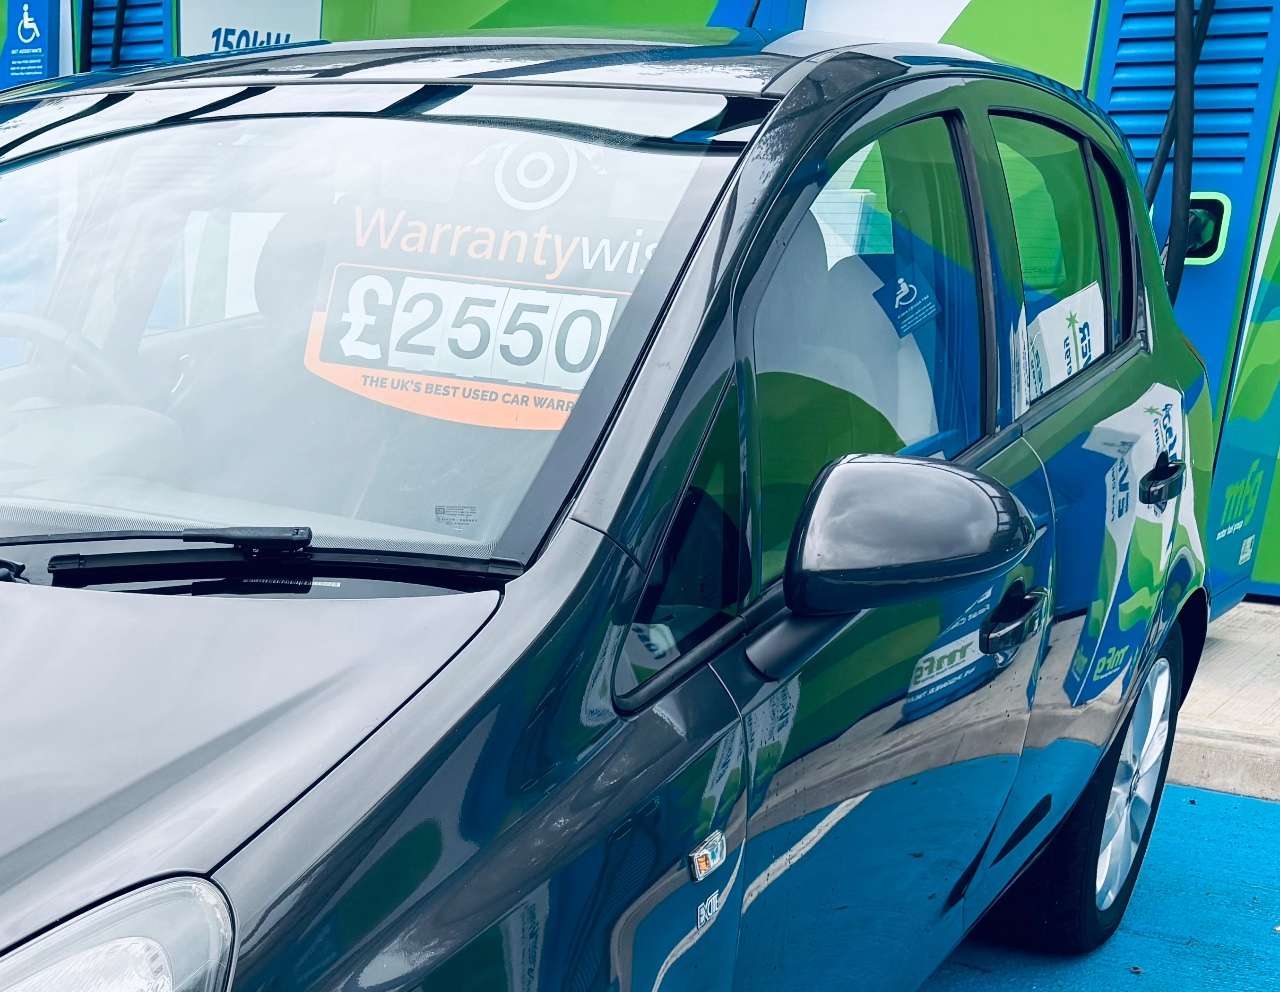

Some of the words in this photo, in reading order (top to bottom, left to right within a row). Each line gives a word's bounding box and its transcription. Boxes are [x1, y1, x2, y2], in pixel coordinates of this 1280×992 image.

[339, 274, 602, 374] £2550
[361, 375, 388, 389] THE
[390, 378, 423, 393] UK'S
[425, 383, 460, 397] BEST
[462, 389, 499, 402] USED
[501, 392, 529, 406] CAR
[1221, 458, 1264, 527] mfg
